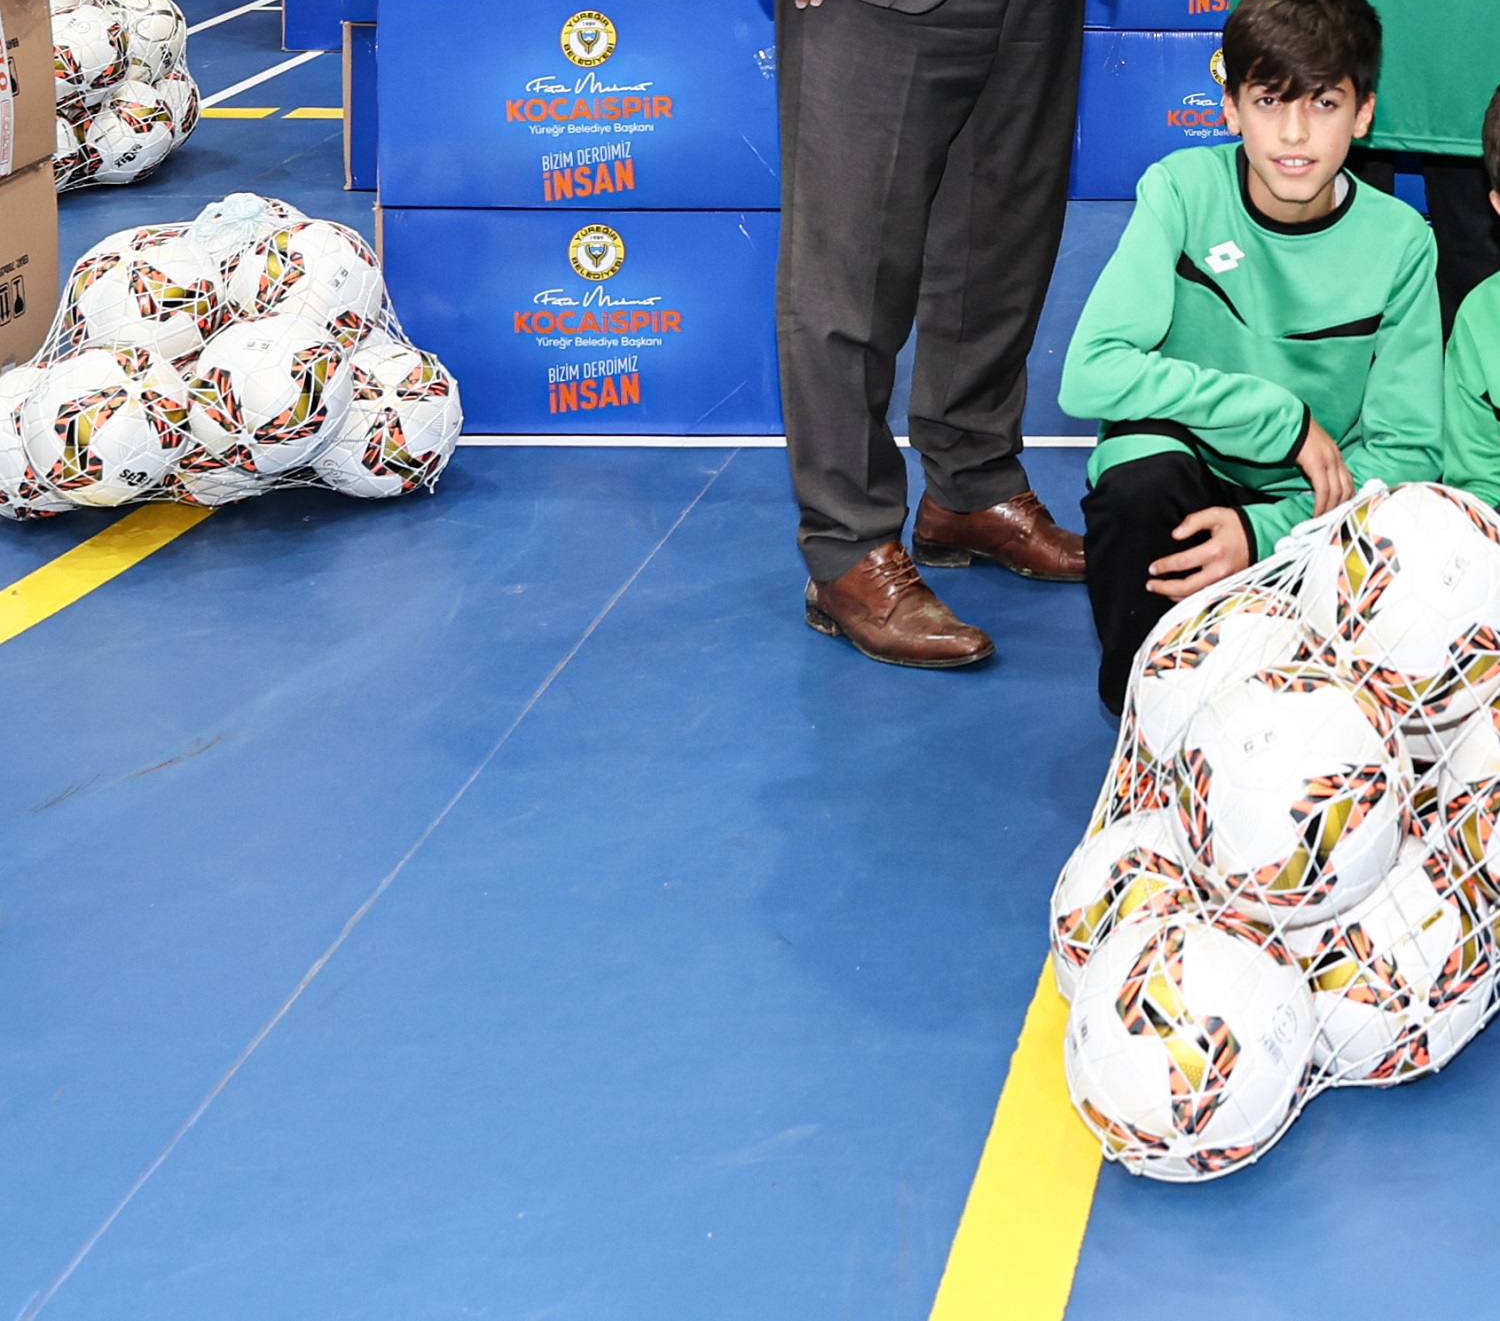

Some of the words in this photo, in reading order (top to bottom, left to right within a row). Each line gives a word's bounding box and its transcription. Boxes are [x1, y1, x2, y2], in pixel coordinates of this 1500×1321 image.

[528, 125, 565, 137] Yüreğir
[568, 124, 611, 135] Belediye
[613, 123, 654, 134] Başkanı
[542, 151, 573, 171] BİZİM
[577, 140, 632, 165] DERDİMİZ
[536, 337, 572, 349] Yüreğir
[575, 337, 619, 349] Belediye
[621, 337, 662, 348] Başkanı
[548, 363, 580, 384] BİZİM
[583, 354, 638, 379] DERDİMİZ
